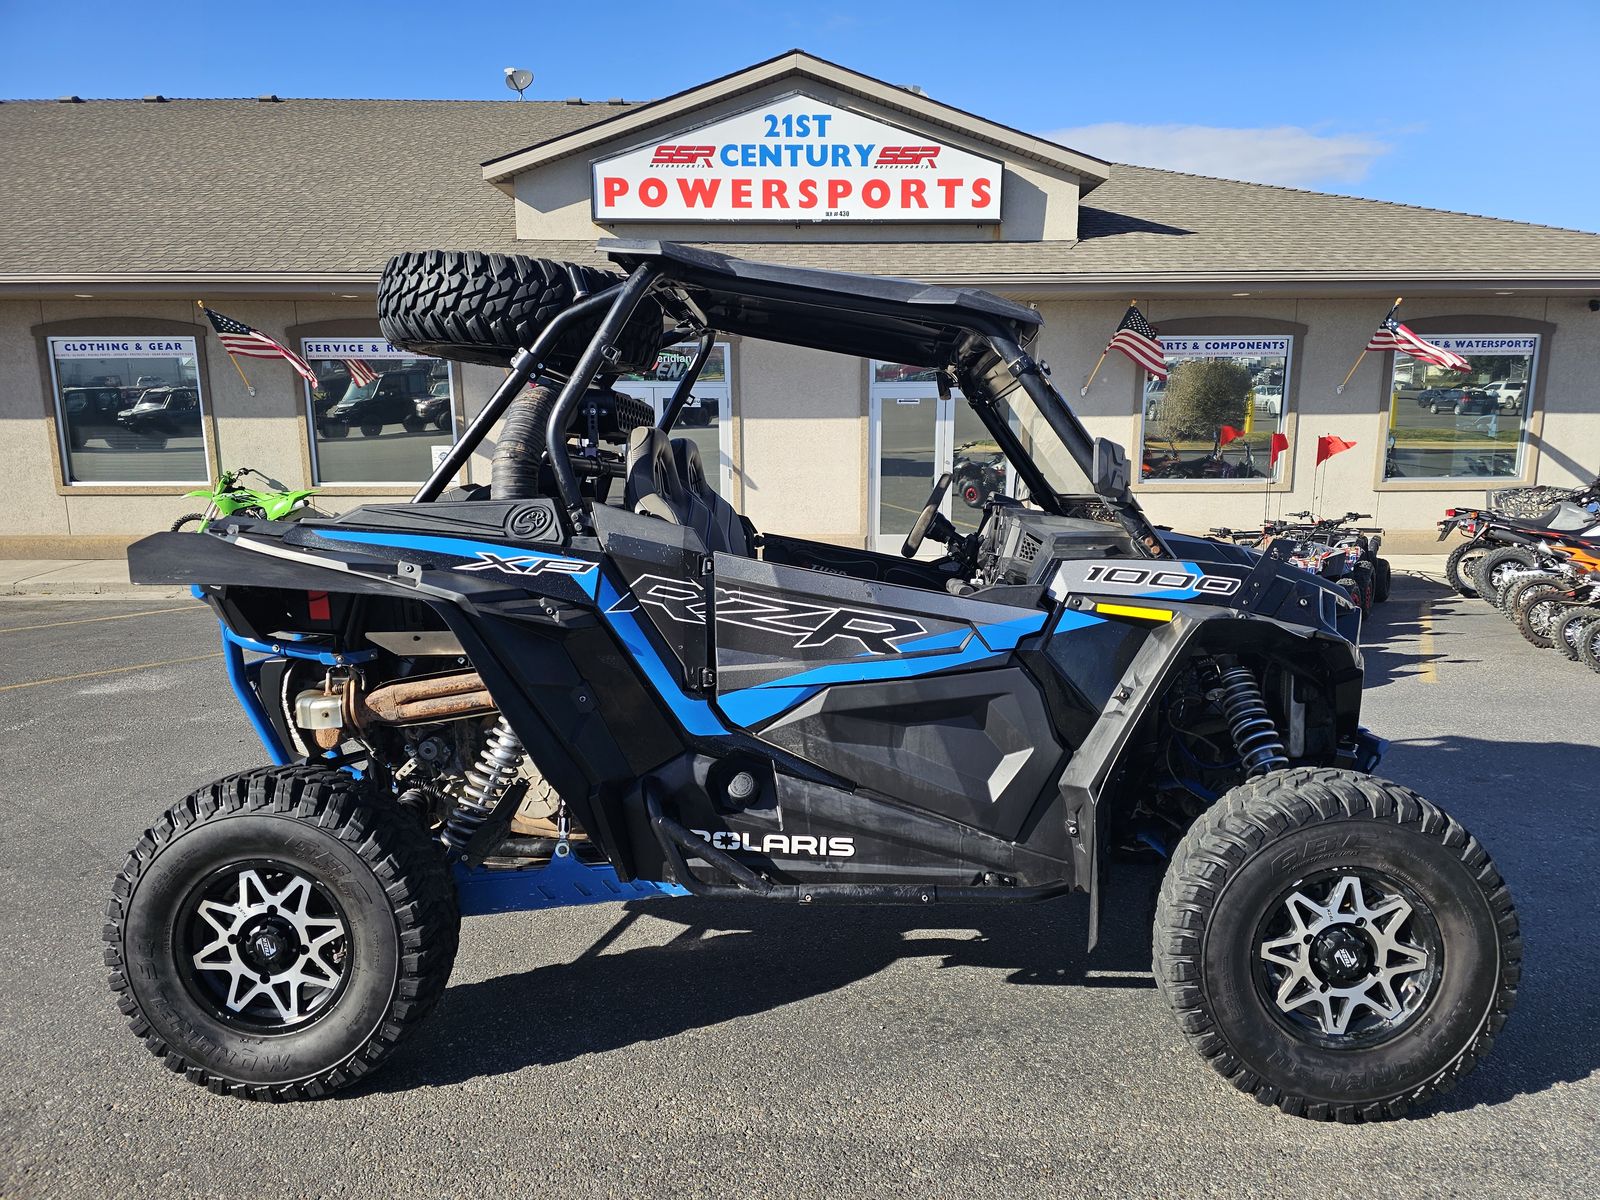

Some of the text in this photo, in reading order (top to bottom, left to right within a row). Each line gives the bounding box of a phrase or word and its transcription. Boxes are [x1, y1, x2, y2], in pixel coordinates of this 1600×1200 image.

[764, 114, 832, 138] 21ST
[651, 145, 717, 168] SSR
[720, 143, 876, 167] CENTURY
[876, 146, 941, 169] SSR
[603, 176, 992, 209] POWERSPORTS
[64, 342, 183, 351] CLOTHING & GEAR
[307, 344, 364, 353] SERVICE
[371, 344, 379, 353] &
[1192, 342, 1200, 350] &
[1204, 341, 1285, 350] COMPONENTS
[1443, 340, 1451, 348] &
[1455, 340, 1534, 348] WATERSPORTS
[657, 353, 692, 363] eridian
[452, 551, 600, 576] XP
[1083, 565, 1242, 596] 1000
[604, 573, 929, 656] RZR
